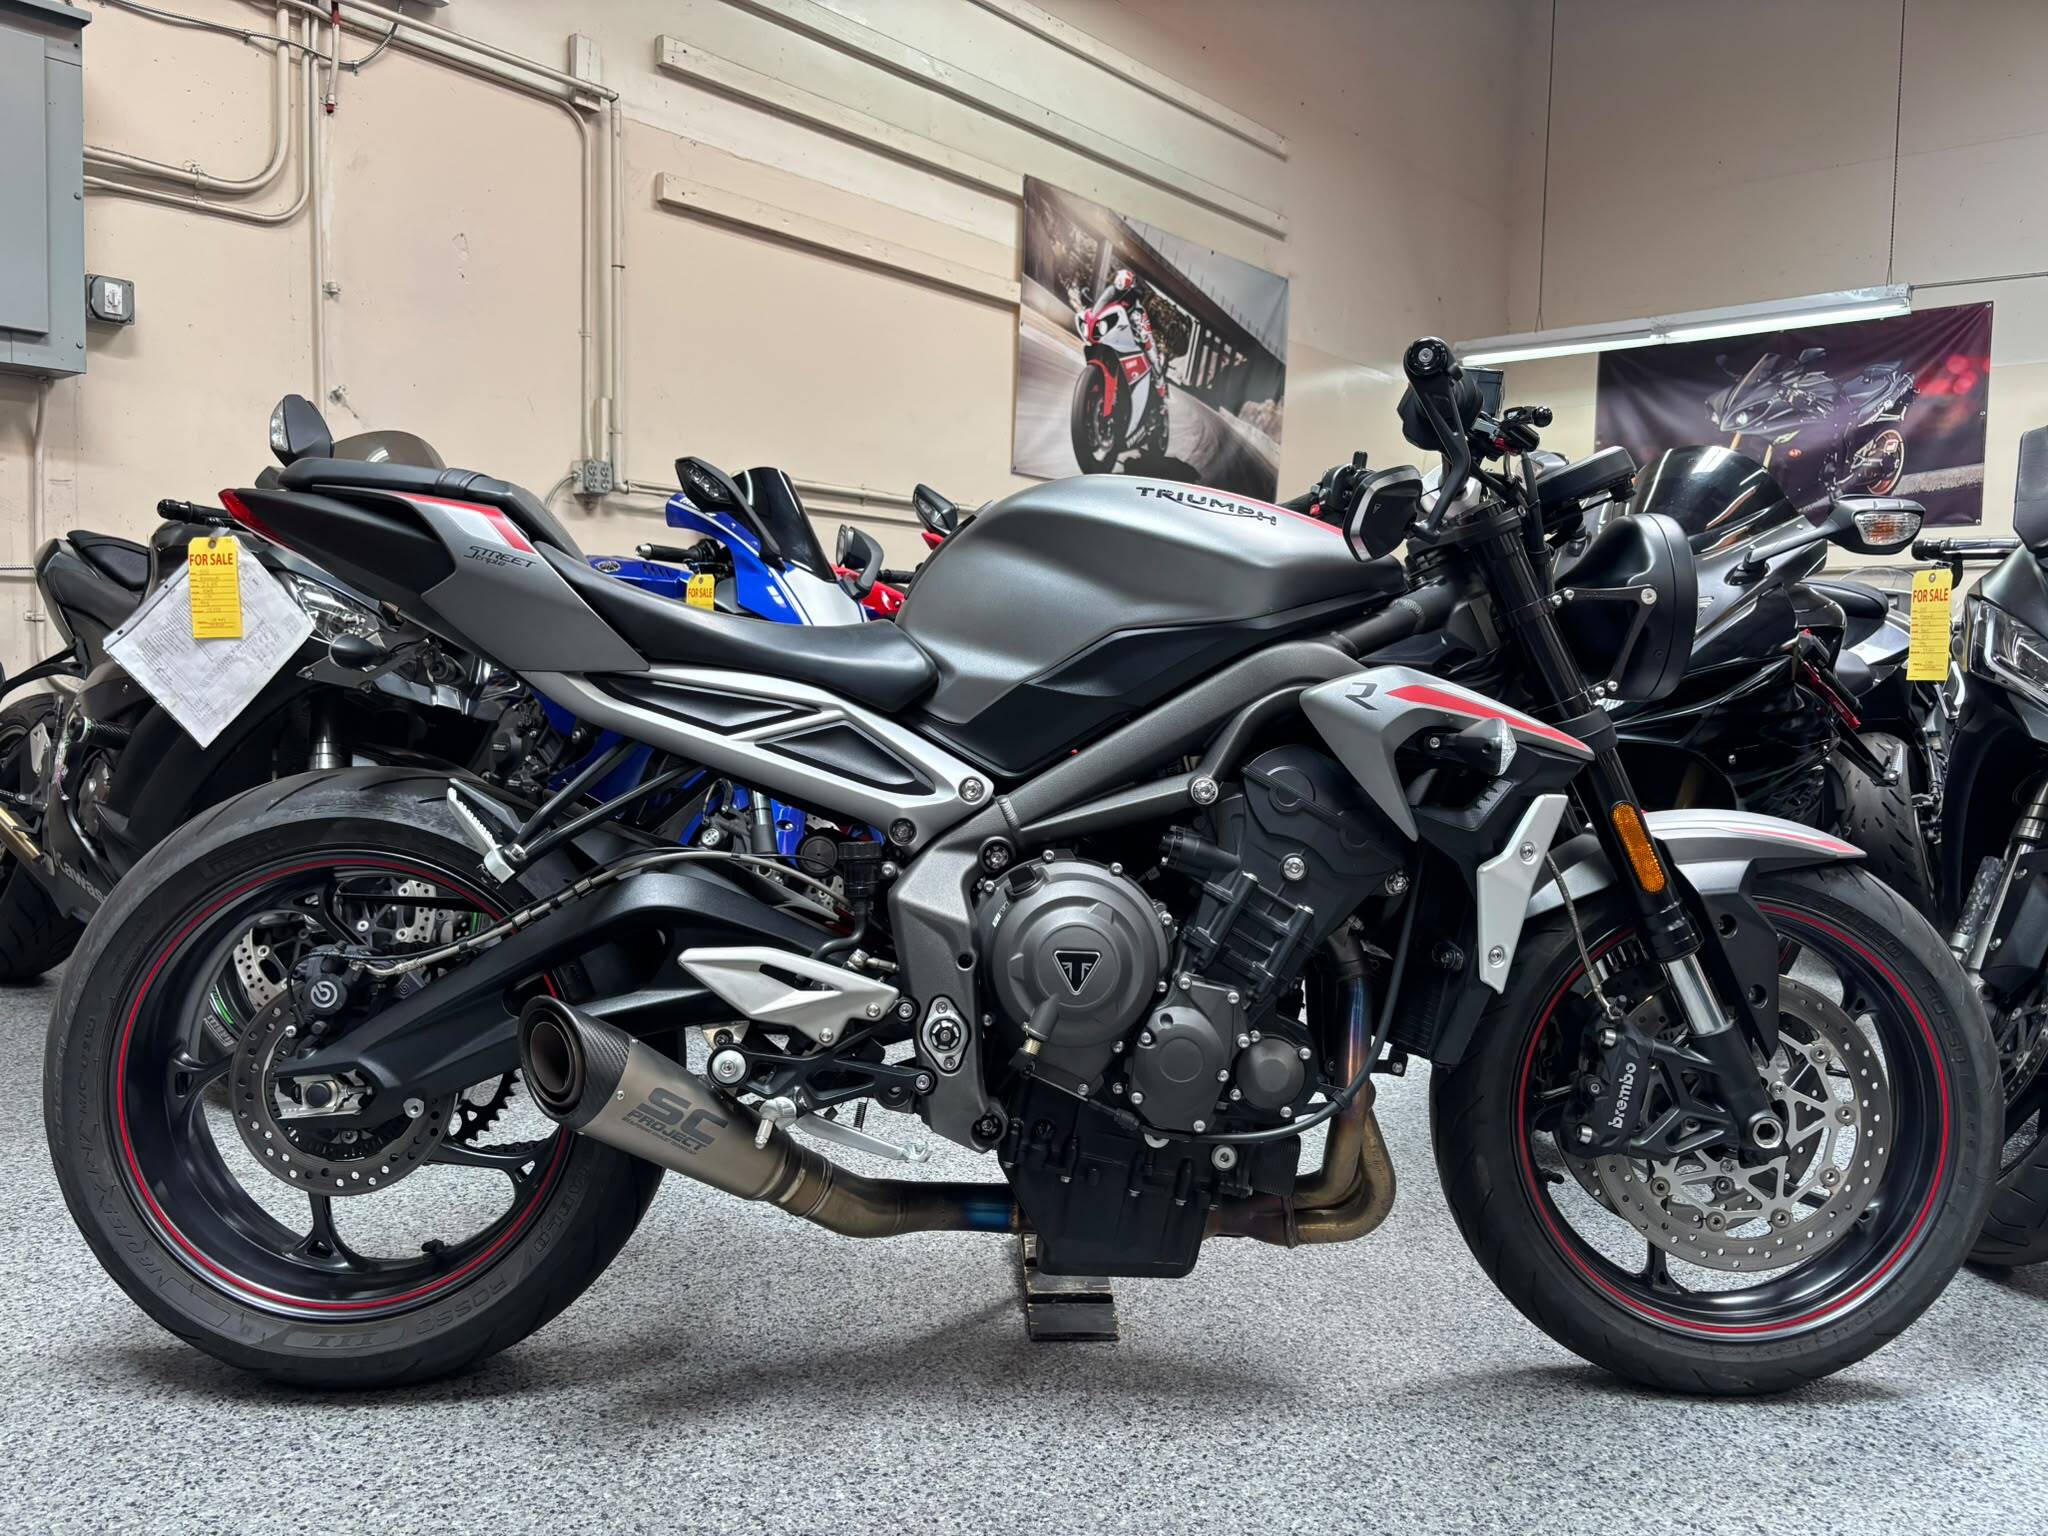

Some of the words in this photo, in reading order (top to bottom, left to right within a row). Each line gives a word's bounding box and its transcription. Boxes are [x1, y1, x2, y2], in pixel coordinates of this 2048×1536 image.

[1136, 487, 1276, 526] TRIUMPH
[189, 553, 208, 566] FOR
[210, 553, 233, 565] SALE
[464, 545, 537, 567] STREET
[688, 588, 698, 598] FOR
[699, 588, 712, 598] SALE
[1913, 589, 1928, 603] FOR
[1929, 588, 1948, 601] SALE
[53, 848, 108, 905] Kawas
[1608, 1062, 1637, 1128] brembo
[622, 1109, 708, 1151] PROJECT
[636, 1087, 729, 1146] SC
[415, 1275, 510, 1335] ROSSO
